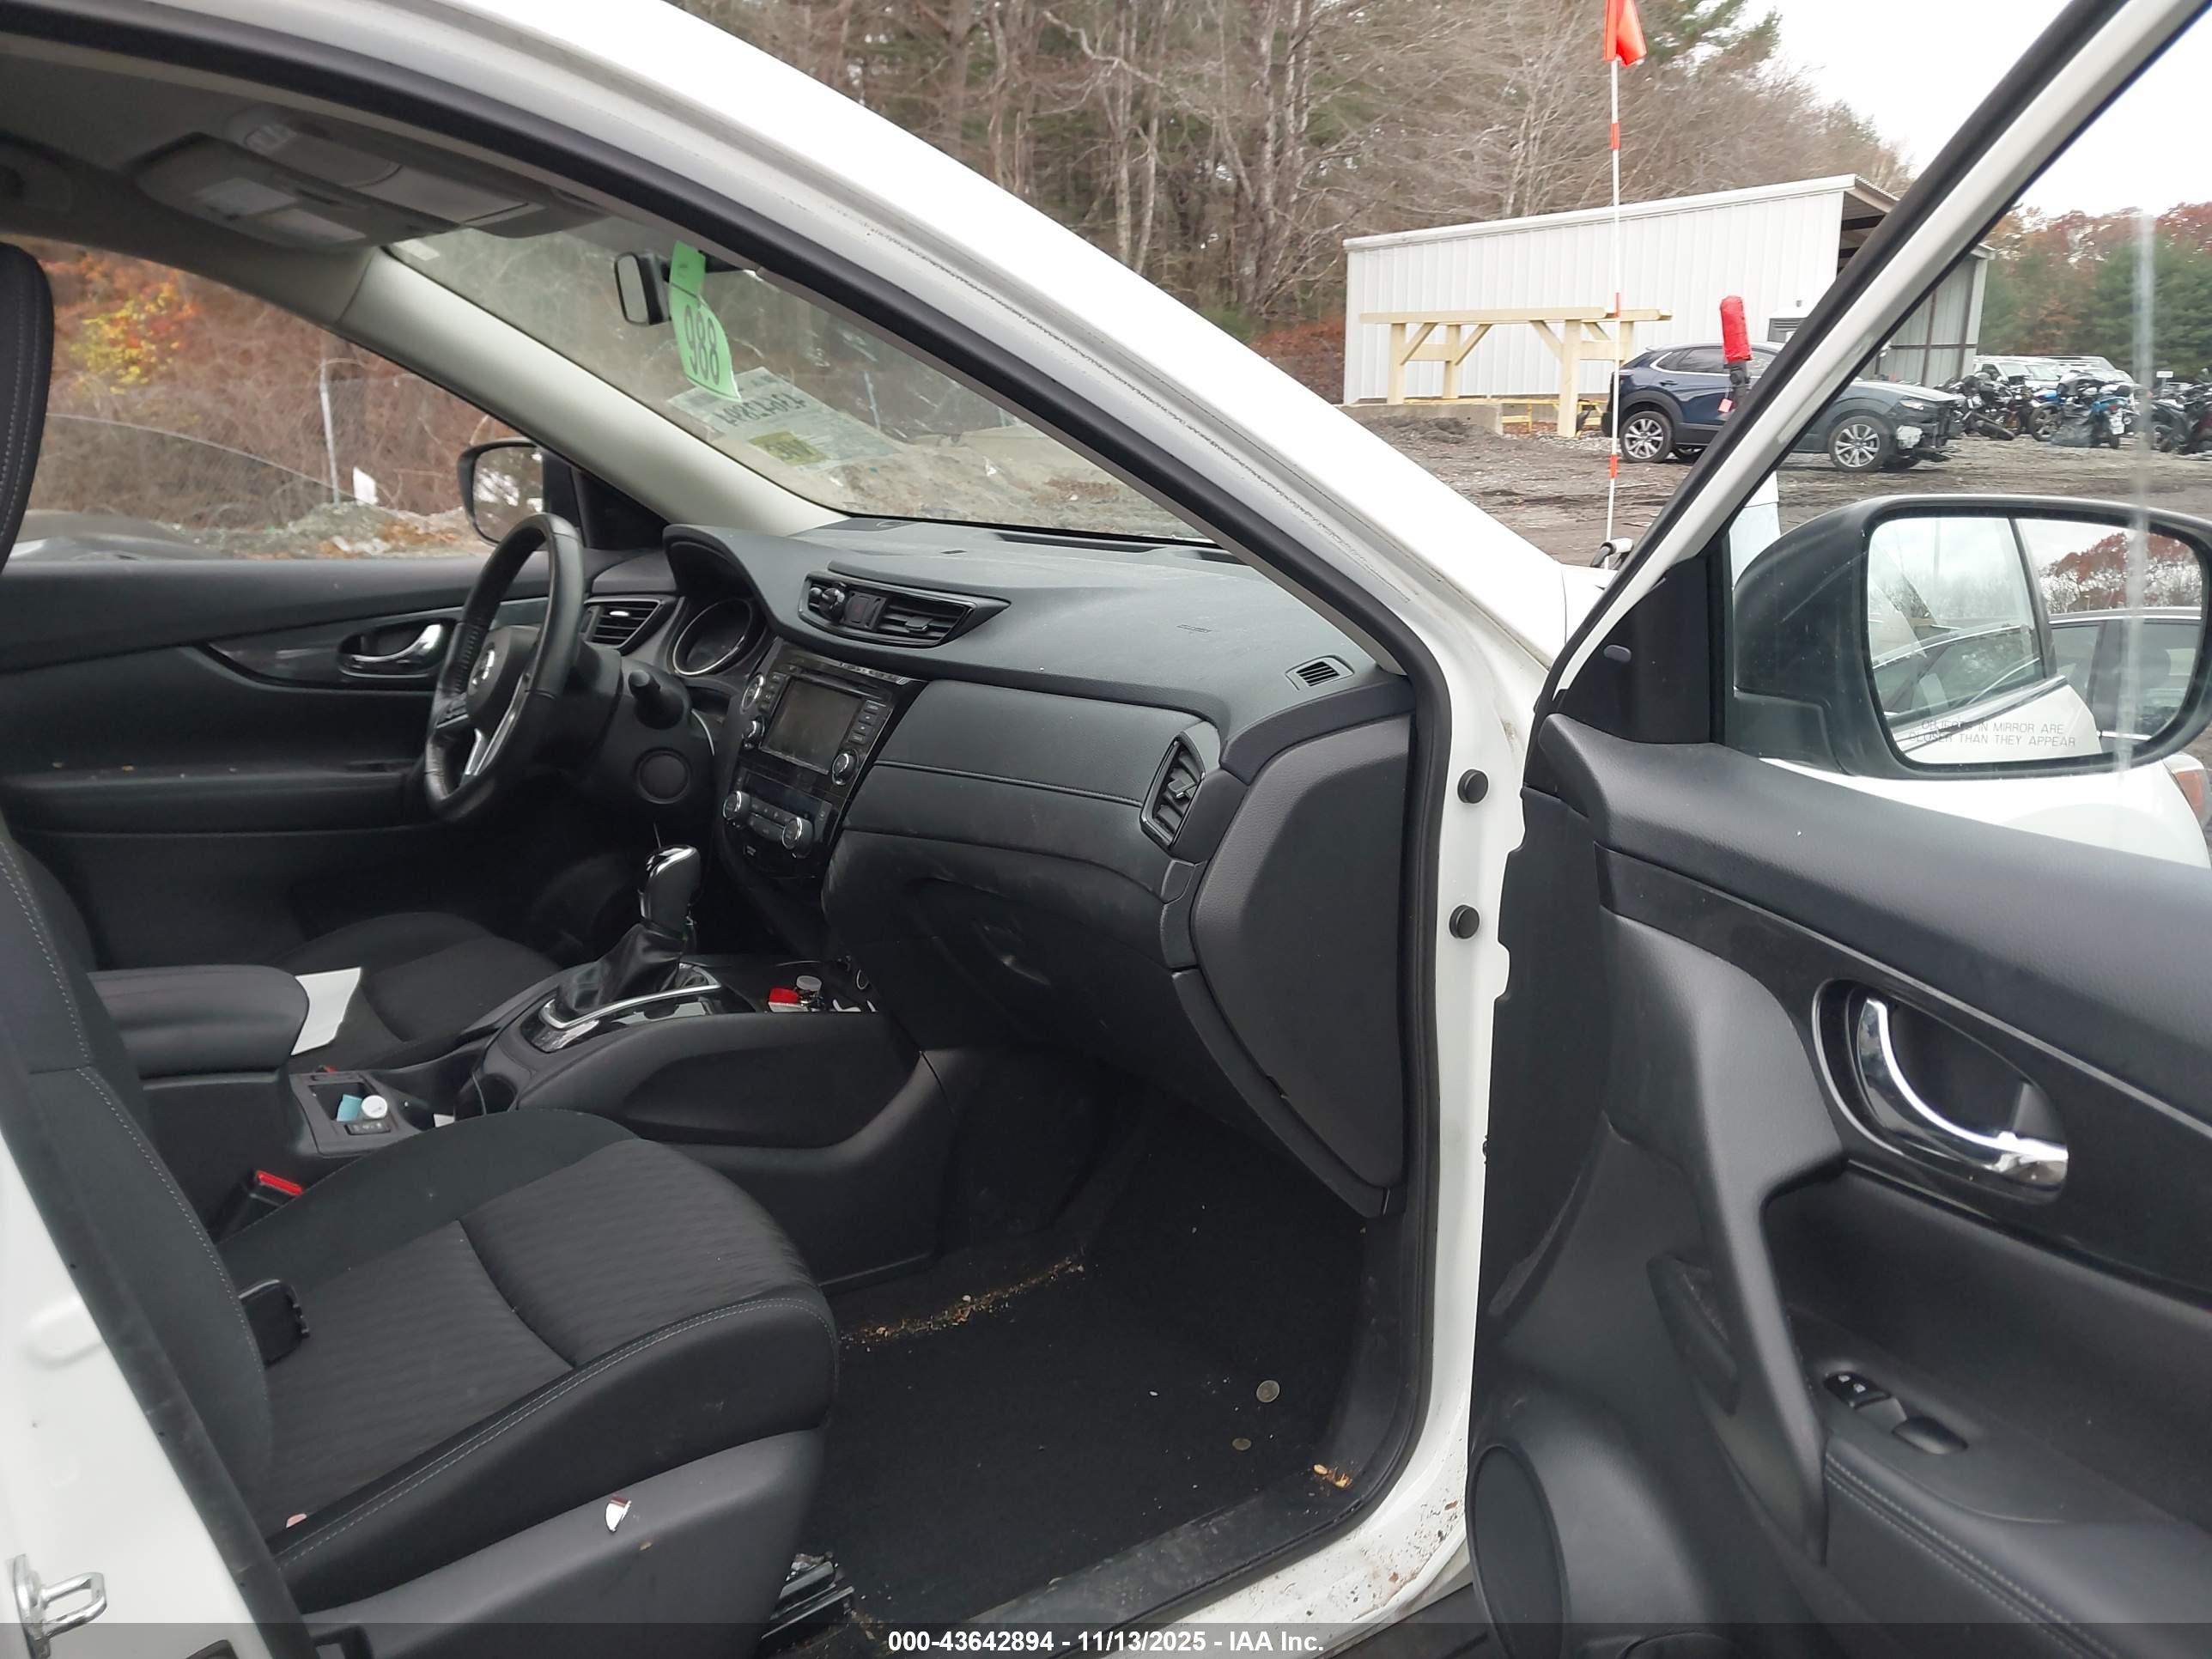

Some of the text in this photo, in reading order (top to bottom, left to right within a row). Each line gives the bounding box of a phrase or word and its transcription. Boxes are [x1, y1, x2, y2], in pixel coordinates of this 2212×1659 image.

[685, 304, 720, 386] 988
[1922, 720, 2064, 734] OBJECT IN MIRROR ARE
[1959, 733, 1988, 744] THAN
[1995, 734, 2021, 745] THEY
[2028, 735, 2075, 747] APPEAR
